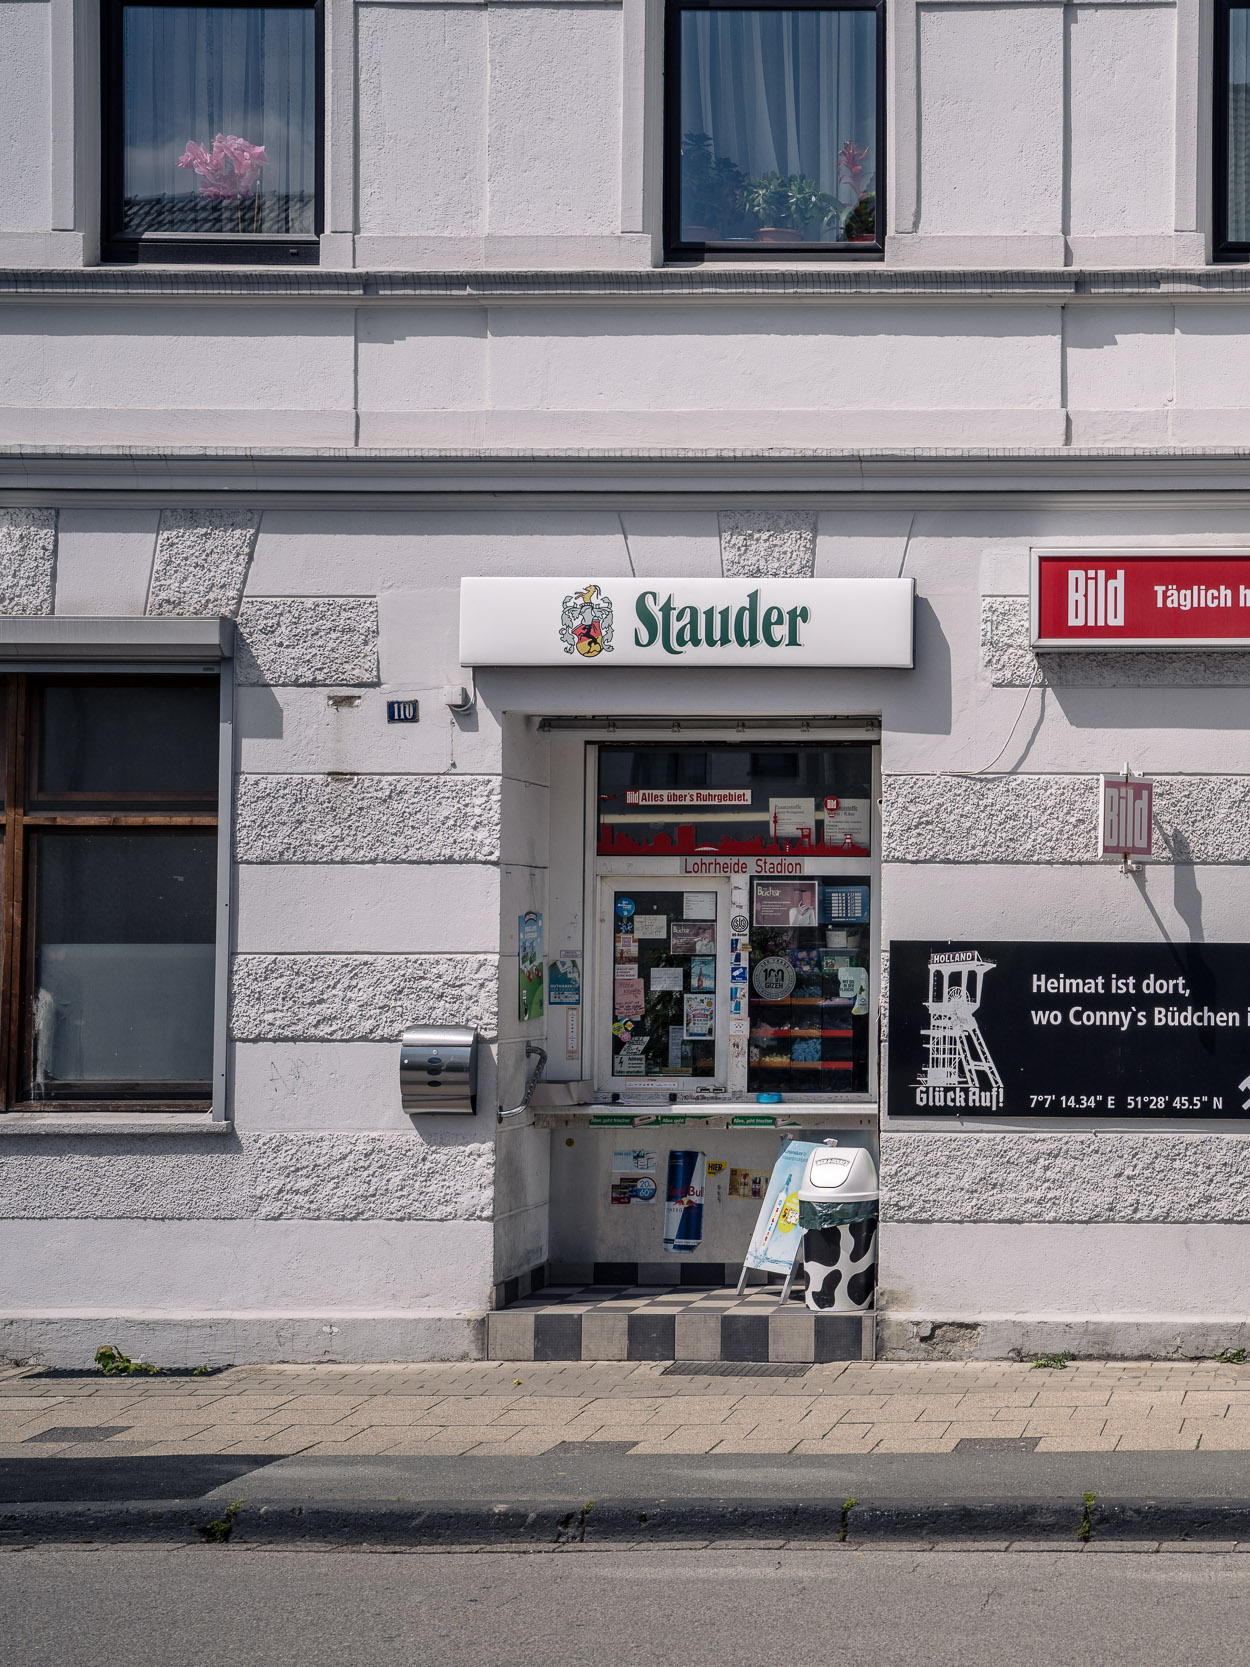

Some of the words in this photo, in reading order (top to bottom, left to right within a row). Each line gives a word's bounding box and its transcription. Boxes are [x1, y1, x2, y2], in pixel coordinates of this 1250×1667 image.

[1068, 570, 1125, 626] Bild
[1154, 585, 1232, 611] Täglich
[634, 588, 811, 655] Stauder
[393, 703, 414, 720] 110
[626, 791, 639, 804] Bild
[641, 792, 664, 802] Alles
[667, 792, 694, 802] über's
[696, 792, 749, 803] Ruhrgebiet.
[1104, 787, 1149, 848] Bild
[684, 858, 748, 874] Lohrheide
[755, 858, 802, 874] Stadion
[933, 952, 972, 964] HOLLAND
[1032, 974, 1105, 994] Heimat
[1111, 974, 1135, 994] ist
[1142, 974, 1191, 997] dort,
[1031, 1010, 1062, 1026] wo
[1154, 1007, 1240, 1027] Büdchen
[915, 1086, 965, 1107] Glück
[968, 1086, 1004, 1111] Auf!
[1108, 1097, 1115, 1108] E
[1213, 1097, 1223, 1109] N
[708, 1163, 723, 1171] HIER
